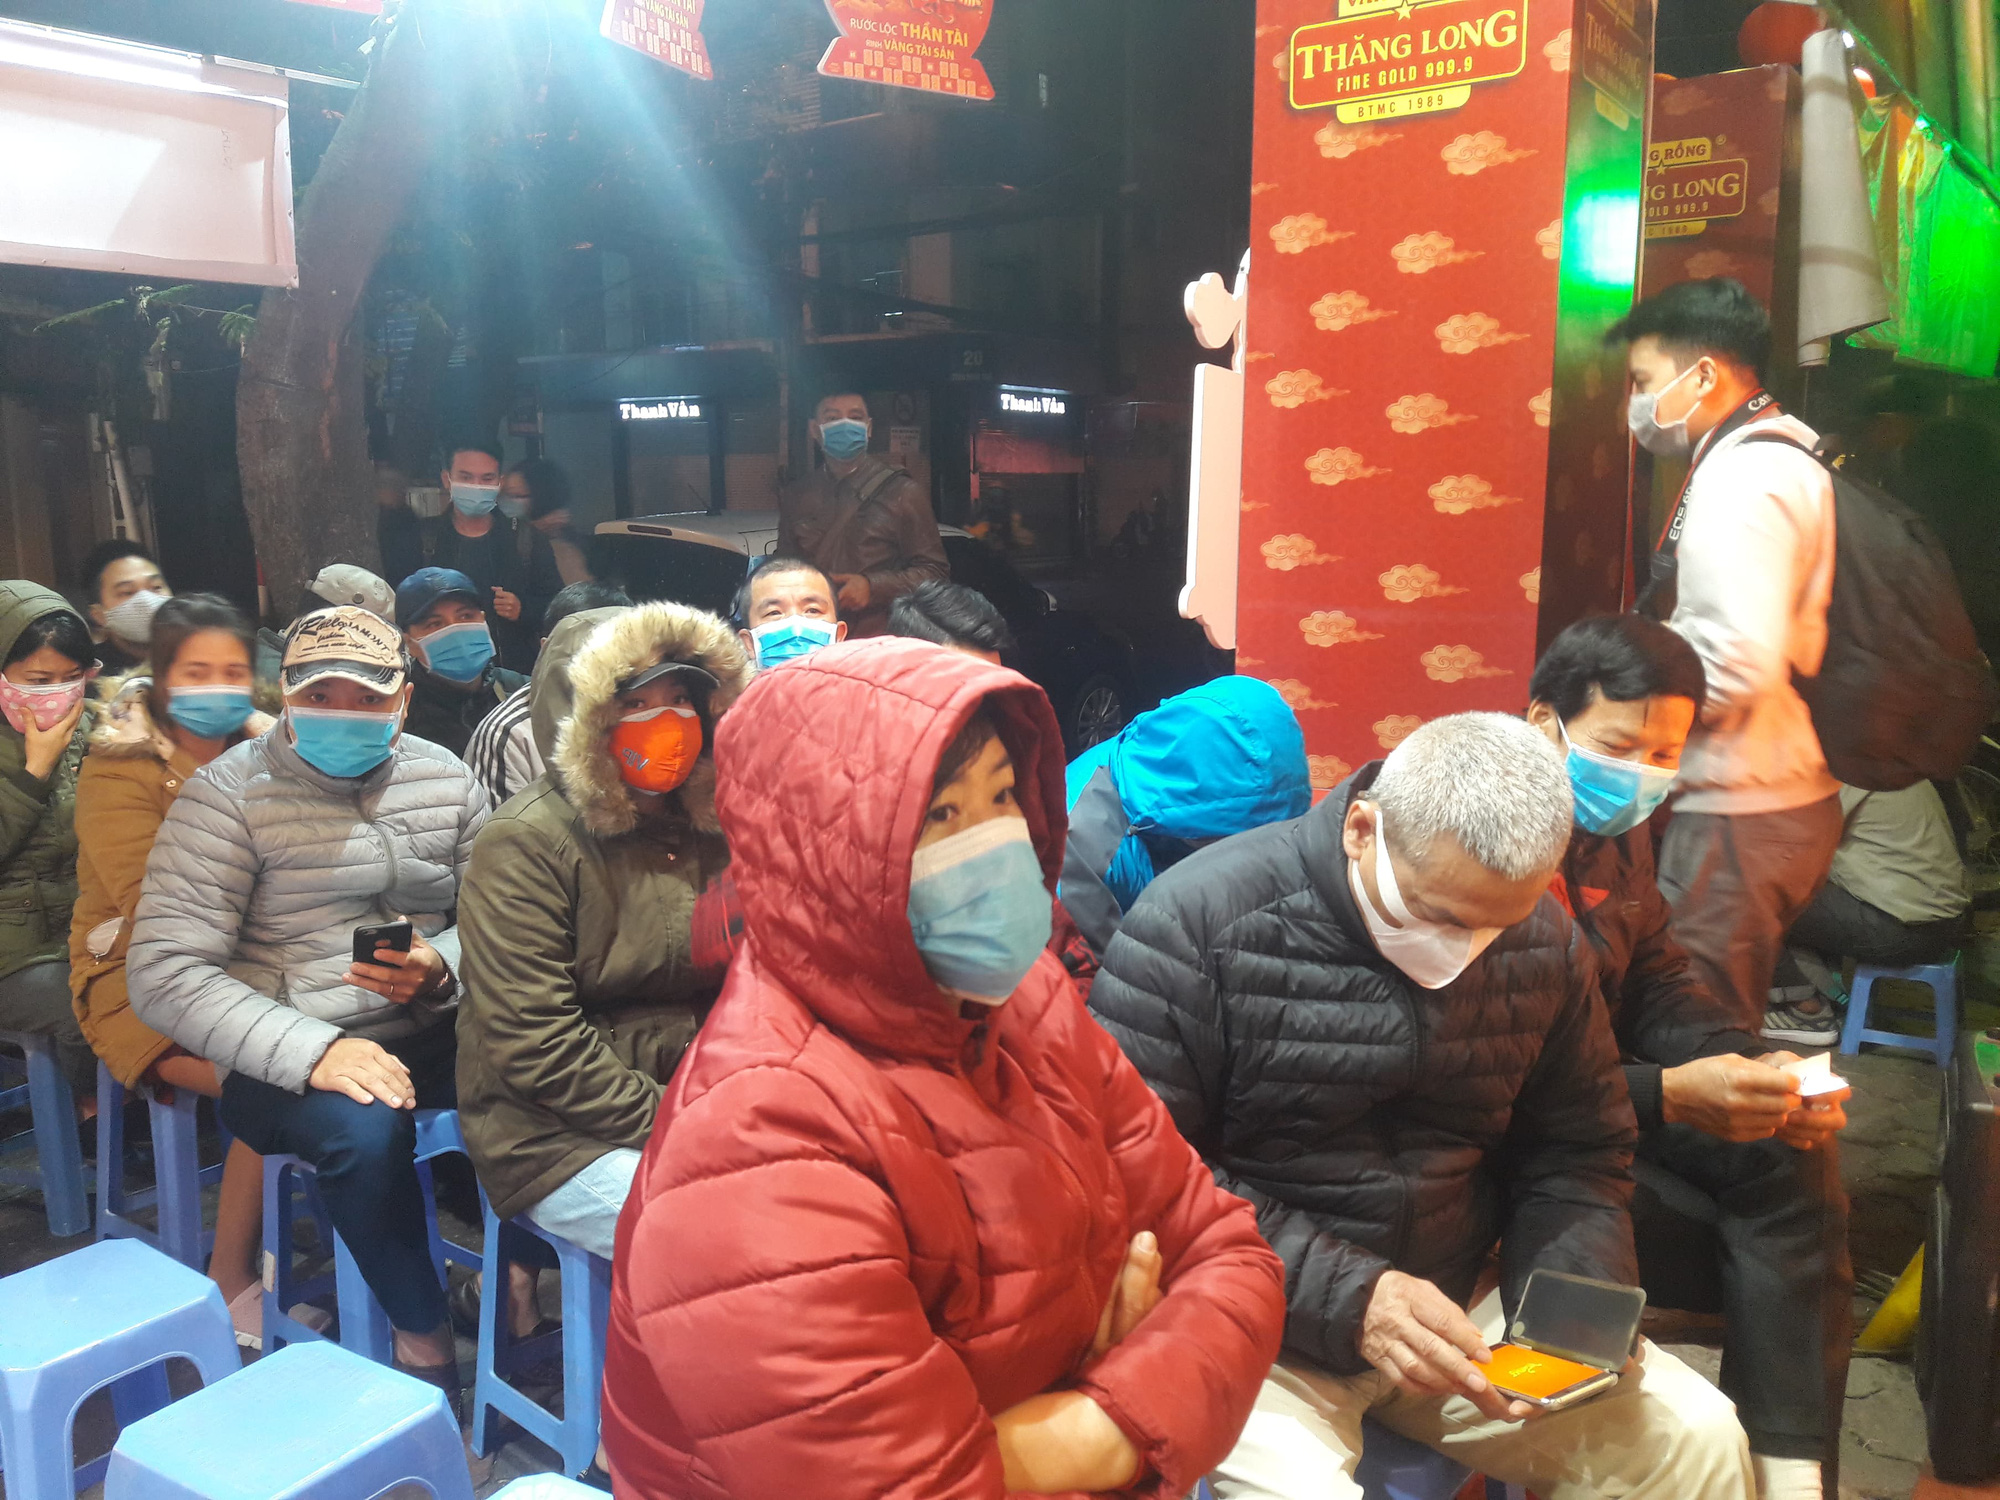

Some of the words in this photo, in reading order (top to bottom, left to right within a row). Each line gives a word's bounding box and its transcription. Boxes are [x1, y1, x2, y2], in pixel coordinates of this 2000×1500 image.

[883, 38, 914, 54] VÀNG
[914, 43, 932, 57] TÀI
[944, 28, 969, 47] TÀI
[1296, 33, 1413, 79] THĂNG
[1421, 10, 1518, 55] LONG
[1337, 73, 1371, 92] FINE
[1378, 65, 1417, 86] GOLD
[1425, 56, 1473, 78] 999.9
[1358, 101, 1397, 118] BTMC
[1408, 94, 1444, 111] 1989
[1672, 173, 1740, 199] LONG
[620, 403, 668, 419] Thanh
[667, 400, 700, 417] Vân
[1000, 393, 1041, 412] Thanh
[1041, 396, 1066, 414] Vân
[1668, 506, 1686, 541] EOS
